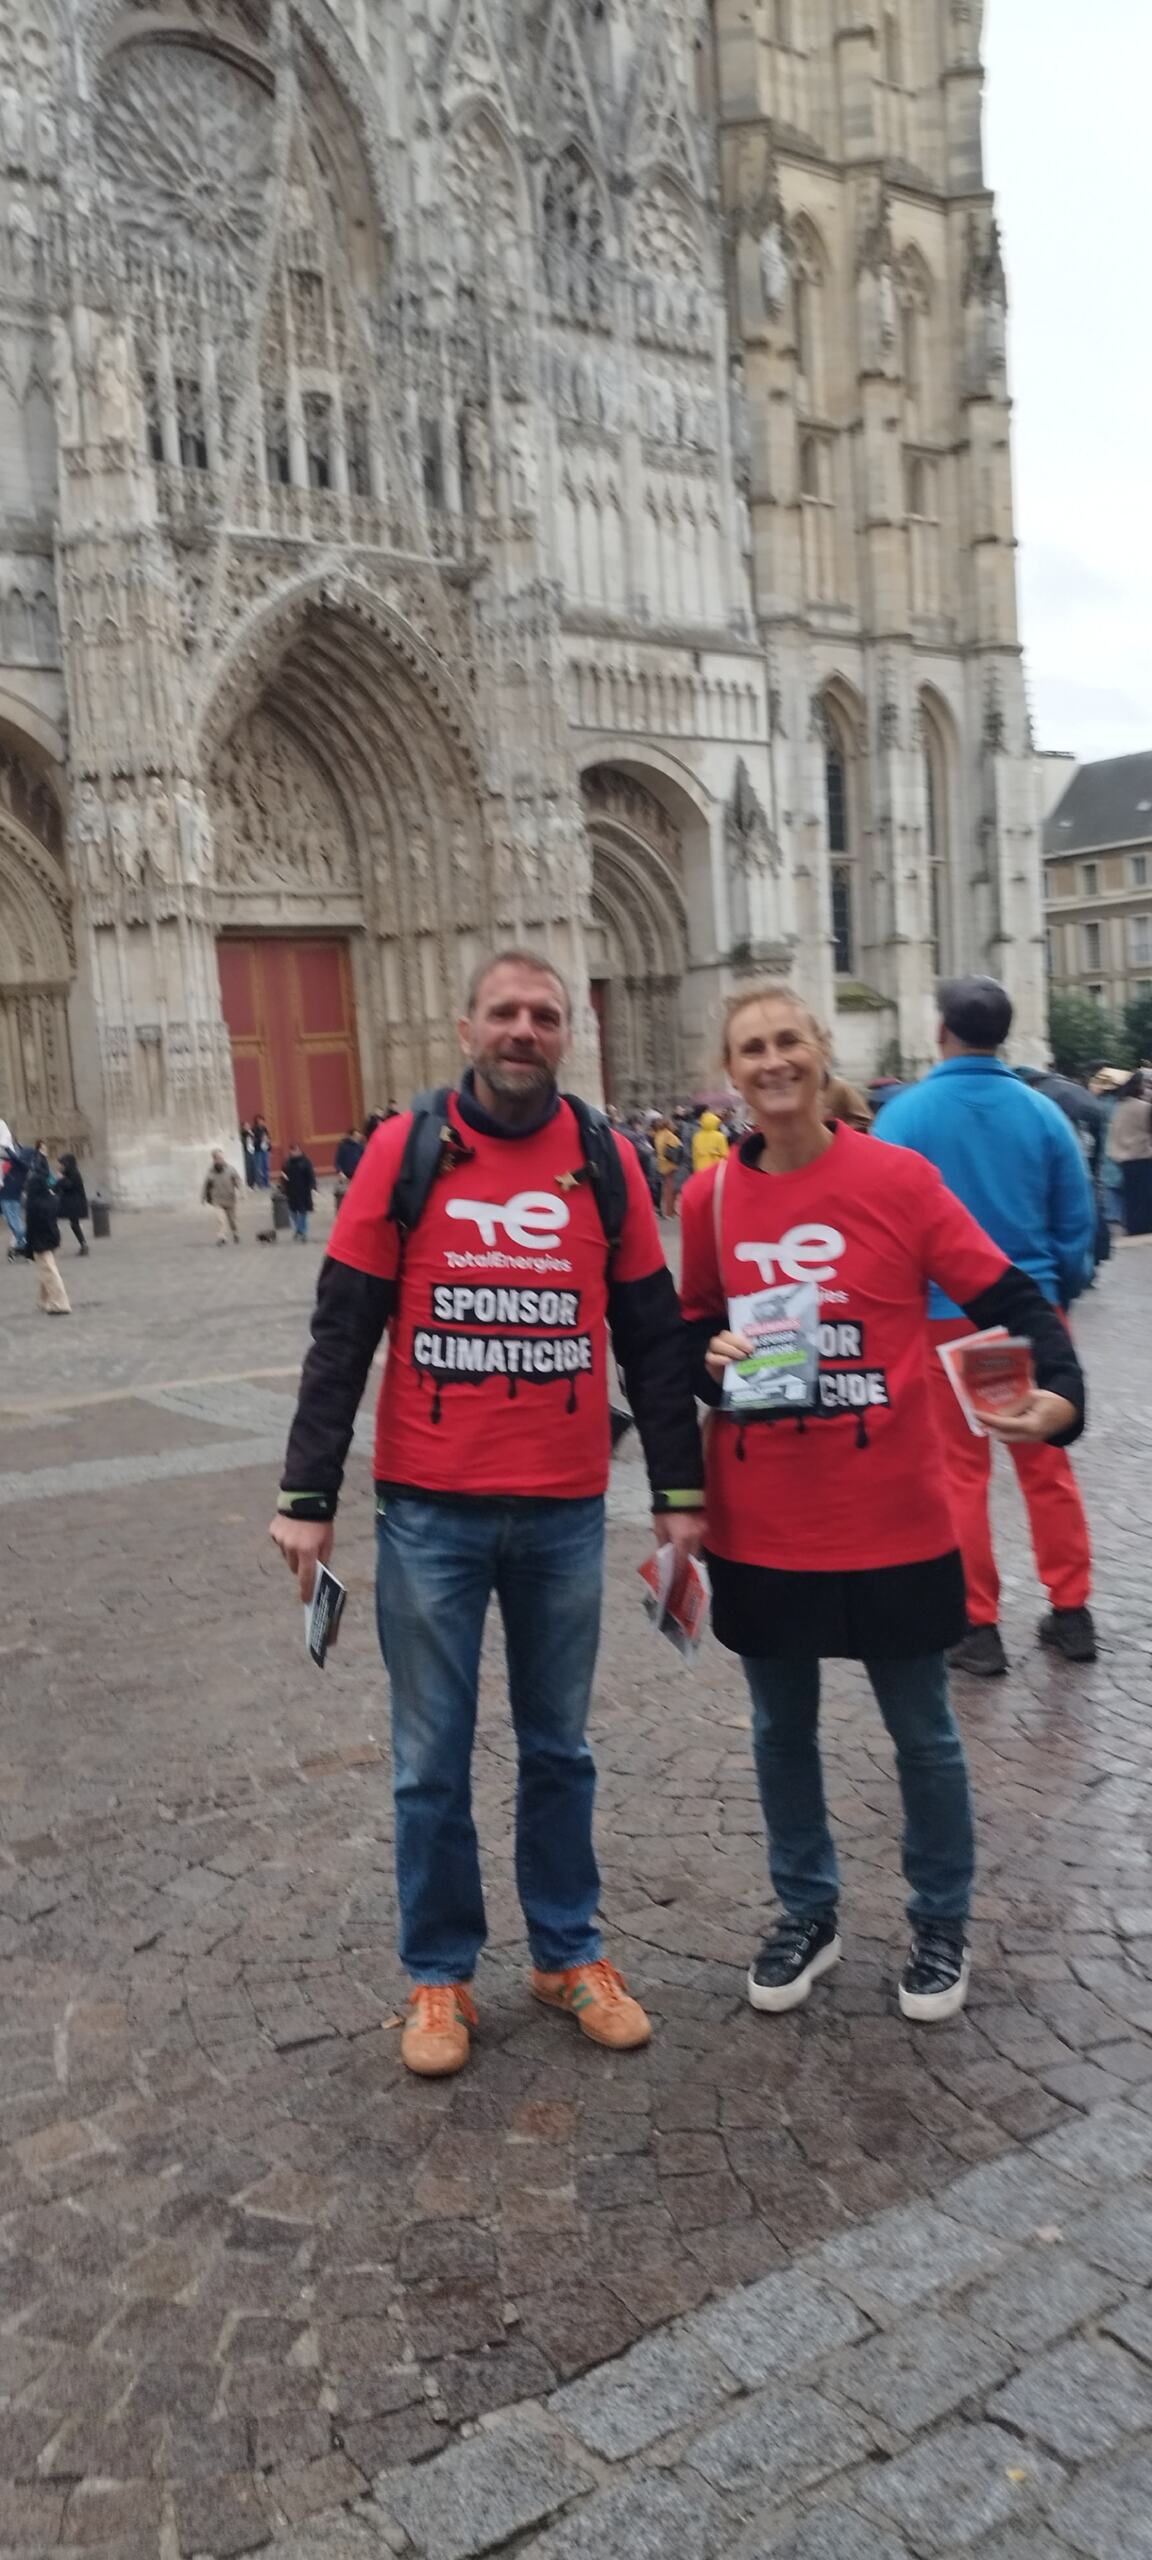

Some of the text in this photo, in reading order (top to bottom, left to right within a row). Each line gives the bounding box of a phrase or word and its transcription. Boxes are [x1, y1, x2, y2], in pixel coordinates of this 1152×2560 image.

[443, 1251, 573, 1273] TotalEnergies
[433, 1286, 579, 1326] SPONSOR
[414, 1331, 593, 1373] CLIMATICIDE
